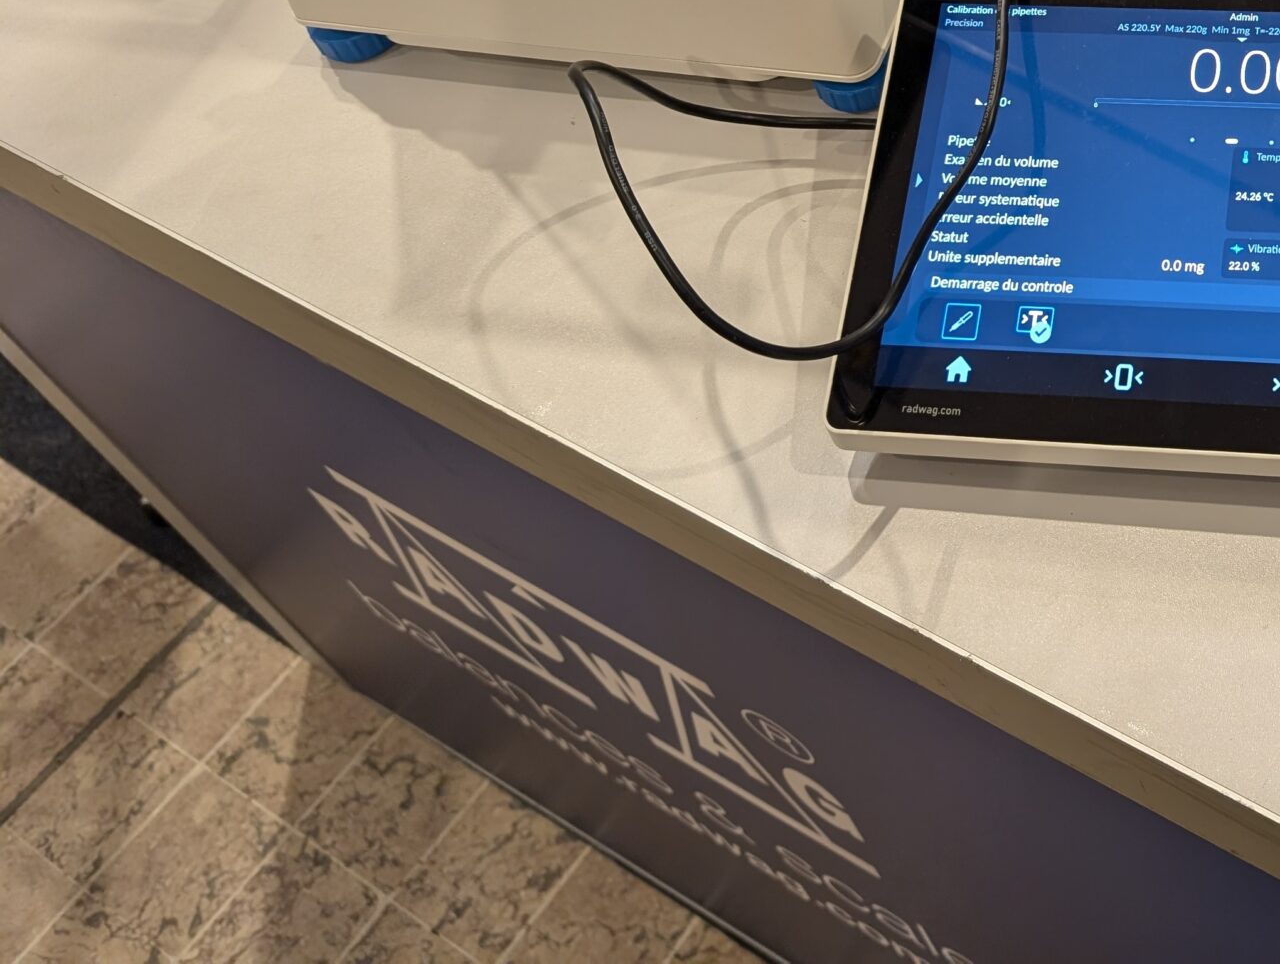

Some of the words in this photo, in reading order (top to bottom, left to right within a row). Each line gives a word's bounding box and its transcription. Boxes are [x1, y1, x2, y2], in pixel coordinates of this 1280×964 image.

[946, 5, 993, 15] Calibration
[1011, 6, 1048, 17] pipettes
[1229, 12, 1259, 22] Admin
[945, 18, 984, 27] Precision
[1117, 23, 1129, 31] AS
[1131, 24, 1161, 32] 220.5Y
[1165, 24, 1184, 33] Max
[1186, 25, 1208, 35] 220g
[1212, 26, 1229, 34] Min
[1232, 26, 1250, 36] 1mg
[947, 135, 991, 148] Pipe
[944, 153, 992, 166] Exaen
[994, 154, 1011, 167] du
[1013, 155, 1059, 168] volume
[990, 176, 1048, 188] moyenne
[938, 191, 976, 204] eur
[978, 194, 1060, 209] systematique
[1235, 191, 1262, 201] 24.26
[976, 213, 1050, 227] accidentelle
[930, 230, 969, 244] Statut
[927, 250, 962, 263] Unite
[964, 252, 1061, 268] supplementaire
[1161, 259, 1182, 272] 0.0
[1184, 262, 1205, 275] mg
[1228, 261, 1250, 272] 22.0
[1251, 262, 1260, 272] %
[930, 276, 1000, 292] Demarrage
[1002, 278, 1019, 291] du
[1021, 280, 1074, 294] controle
[901, 404, 961, 417] radwag.com
[306, 486, 866, 844] RADWAG
[346, 579, 673, 795] balances
[694, 790, 756, 845] &
